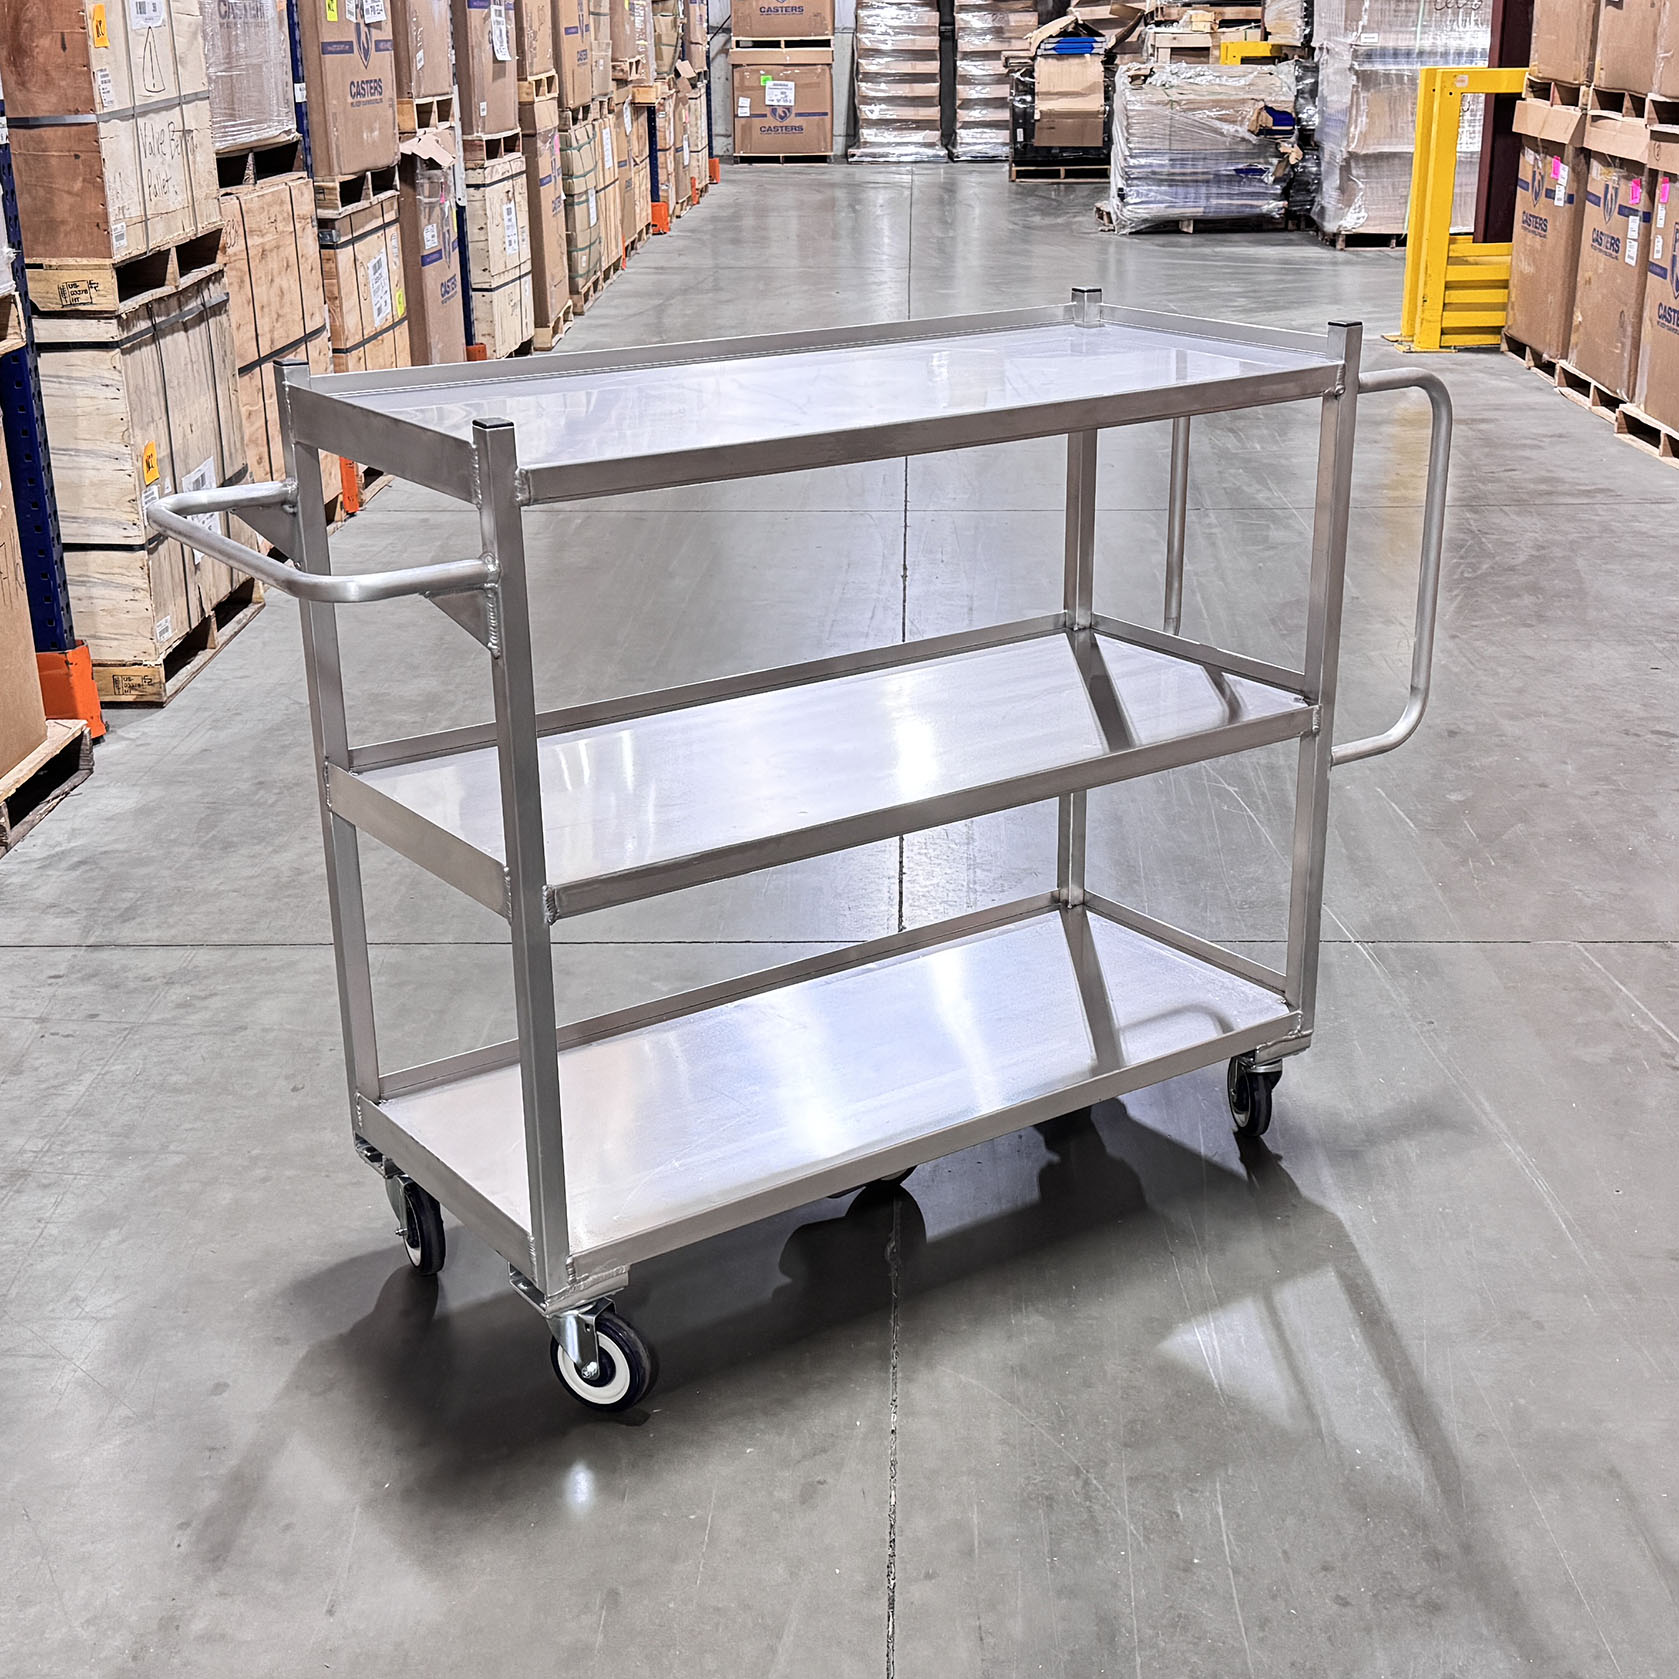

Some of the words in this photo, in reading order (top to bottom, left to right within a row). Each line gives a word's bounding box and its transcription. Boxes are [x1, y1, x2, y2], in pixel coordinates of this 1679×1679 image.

[349, 77, 383, 100] CASTERS
[759, 125, 804, 133] CASTERS
[1521, 210, 1549, 233] CASTERS
[1591, 227, 1621, 255] CASTERS
